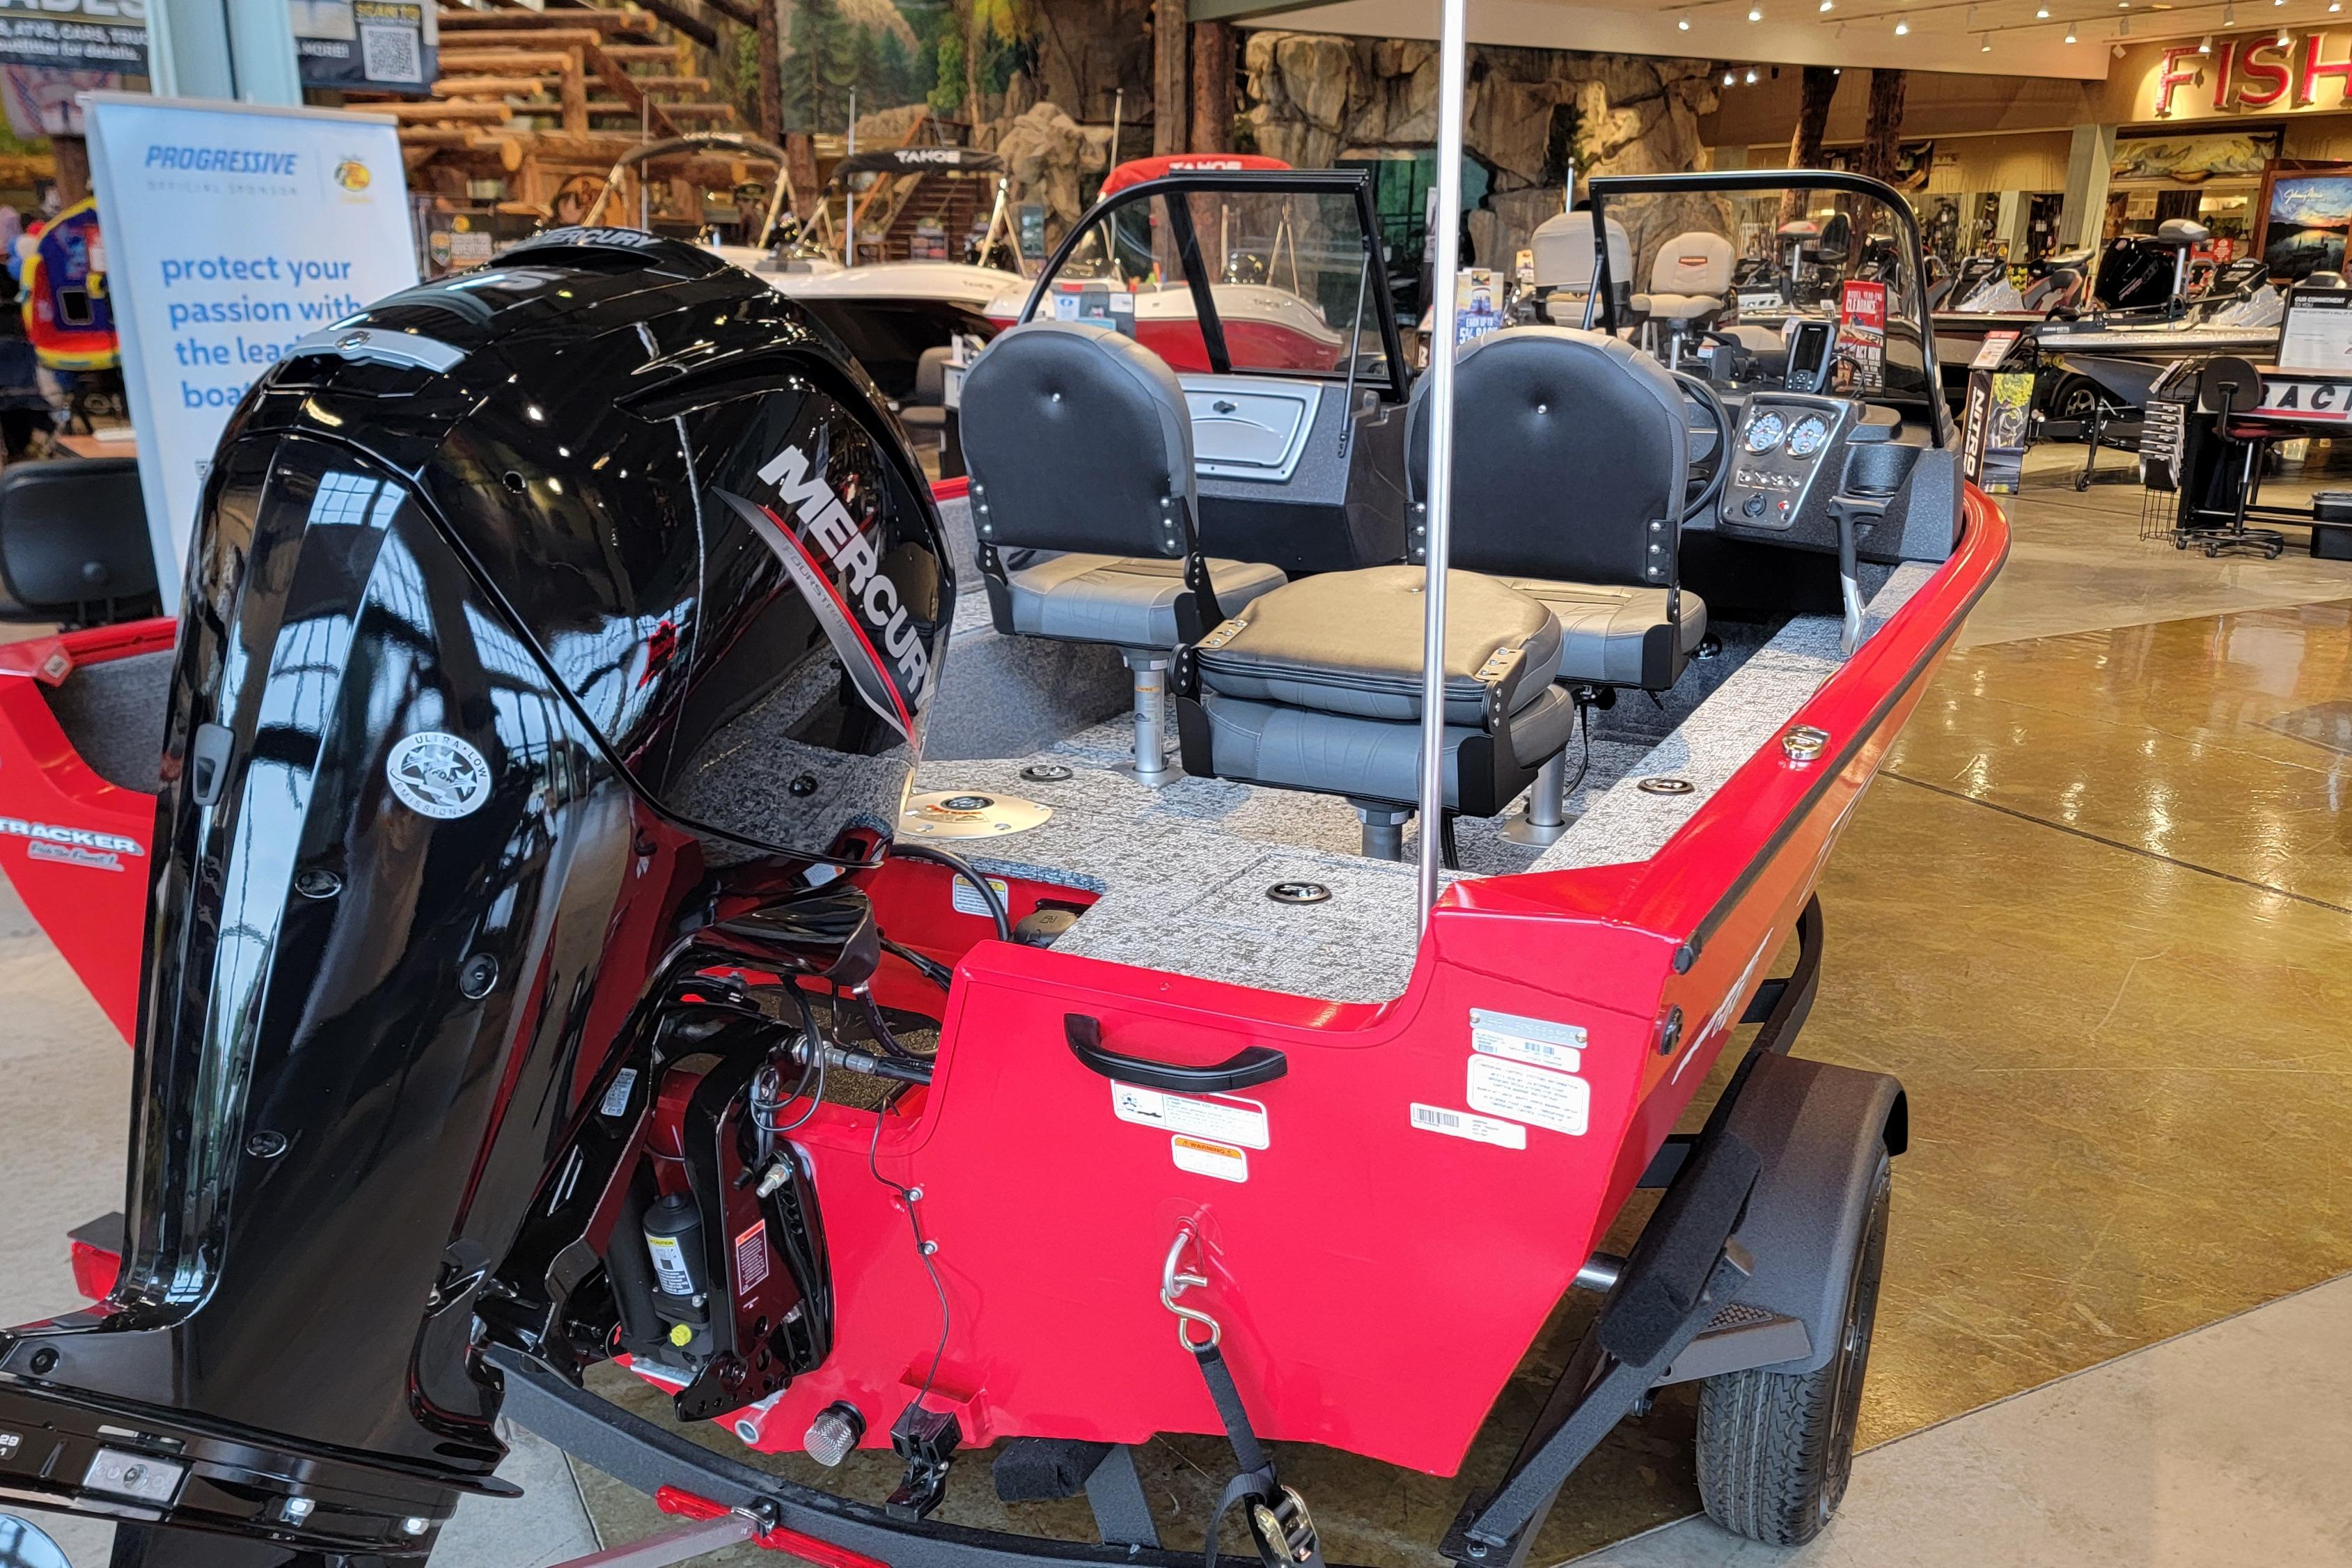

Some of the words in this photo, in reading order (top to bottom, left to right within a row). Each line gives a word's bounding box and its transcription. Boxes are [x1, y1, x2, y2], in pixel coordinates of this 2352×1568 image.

[145, 145, 297, 175] PROGRESSIVE
[894, 150, 962, 164] TAHOE
[161, 256, 280, 288] protect
[286, 260, 352, 287] your
[168, 295, 290, 331] passion
[298, 294, 362, 321] with
[175, 338, 230, 366] the
[1966, 389, 1985, 477] NITRO
[757, 444, 935, 709] MERCURY
[467, 751, 488, 778] LOW
[394, 781, 457, 816] EMISSION
[0, 818, 136, 853] TRACKER
[1189, 1141, 1226, 1154] WARNING
